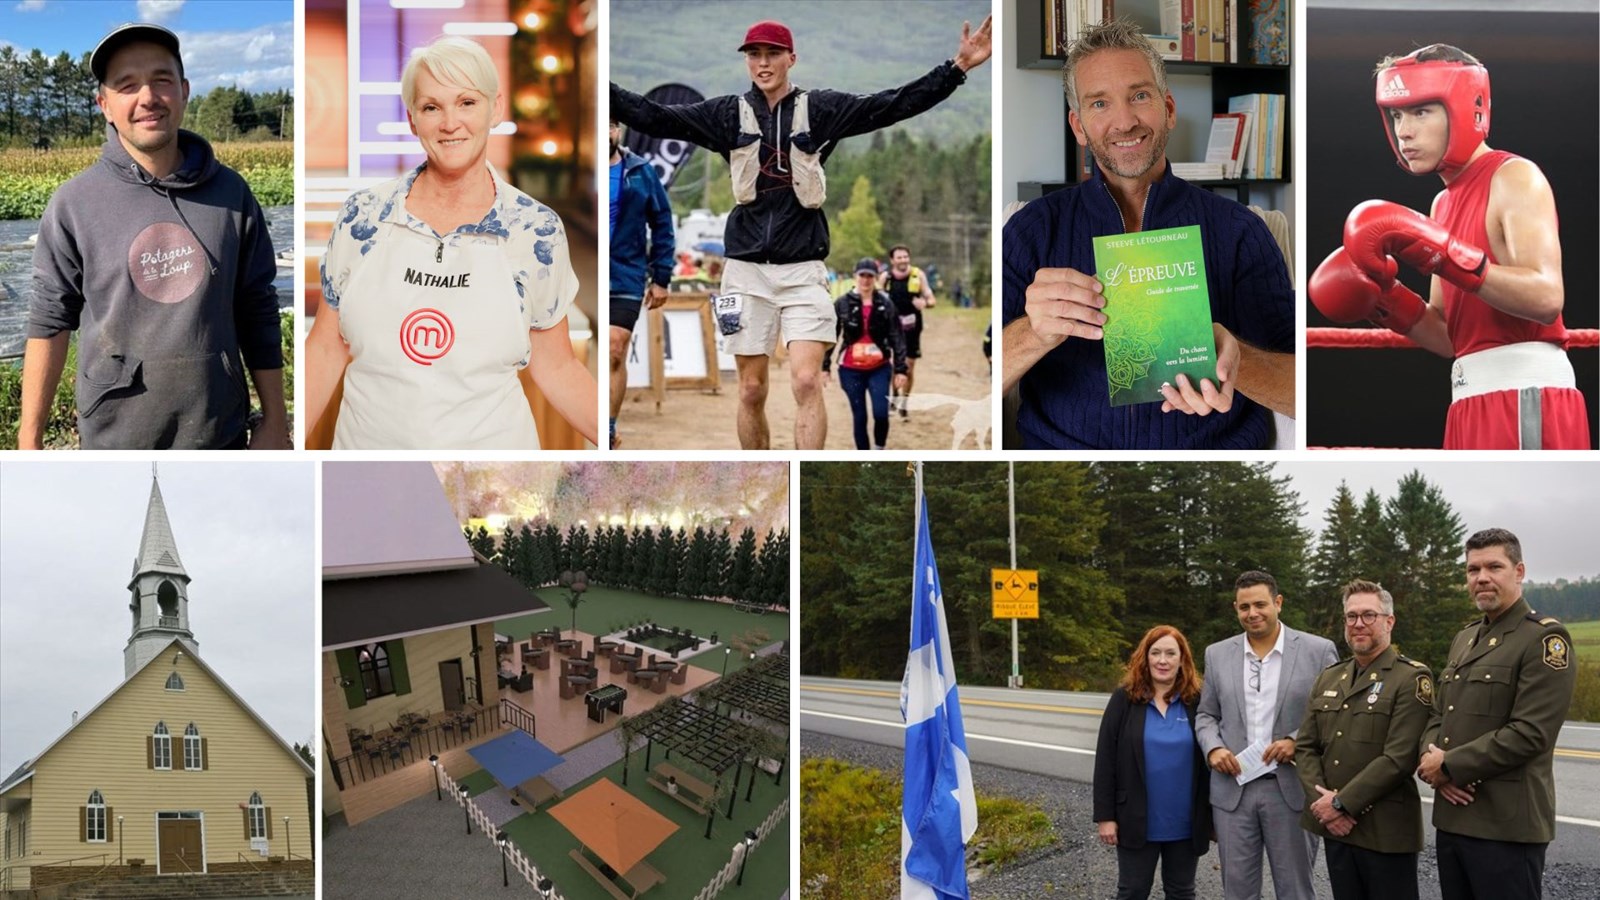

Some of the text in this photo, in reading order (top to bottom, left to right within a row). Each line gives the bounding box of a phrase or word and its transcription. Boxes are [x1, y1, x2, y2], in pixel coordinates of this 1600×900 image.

[1106, 232, 1188, 249] STEEVE LÉTOURNEAU
[141, 245, 195, 266] Potagers
[160, 260, 193, 278] Loup
[404, 267, 471, 288] NATHALIE
[718, 296, 736, 308] 233
[1180, 345, 1208, 355] Du chaos
[1178, 356, 1185, 364] la
